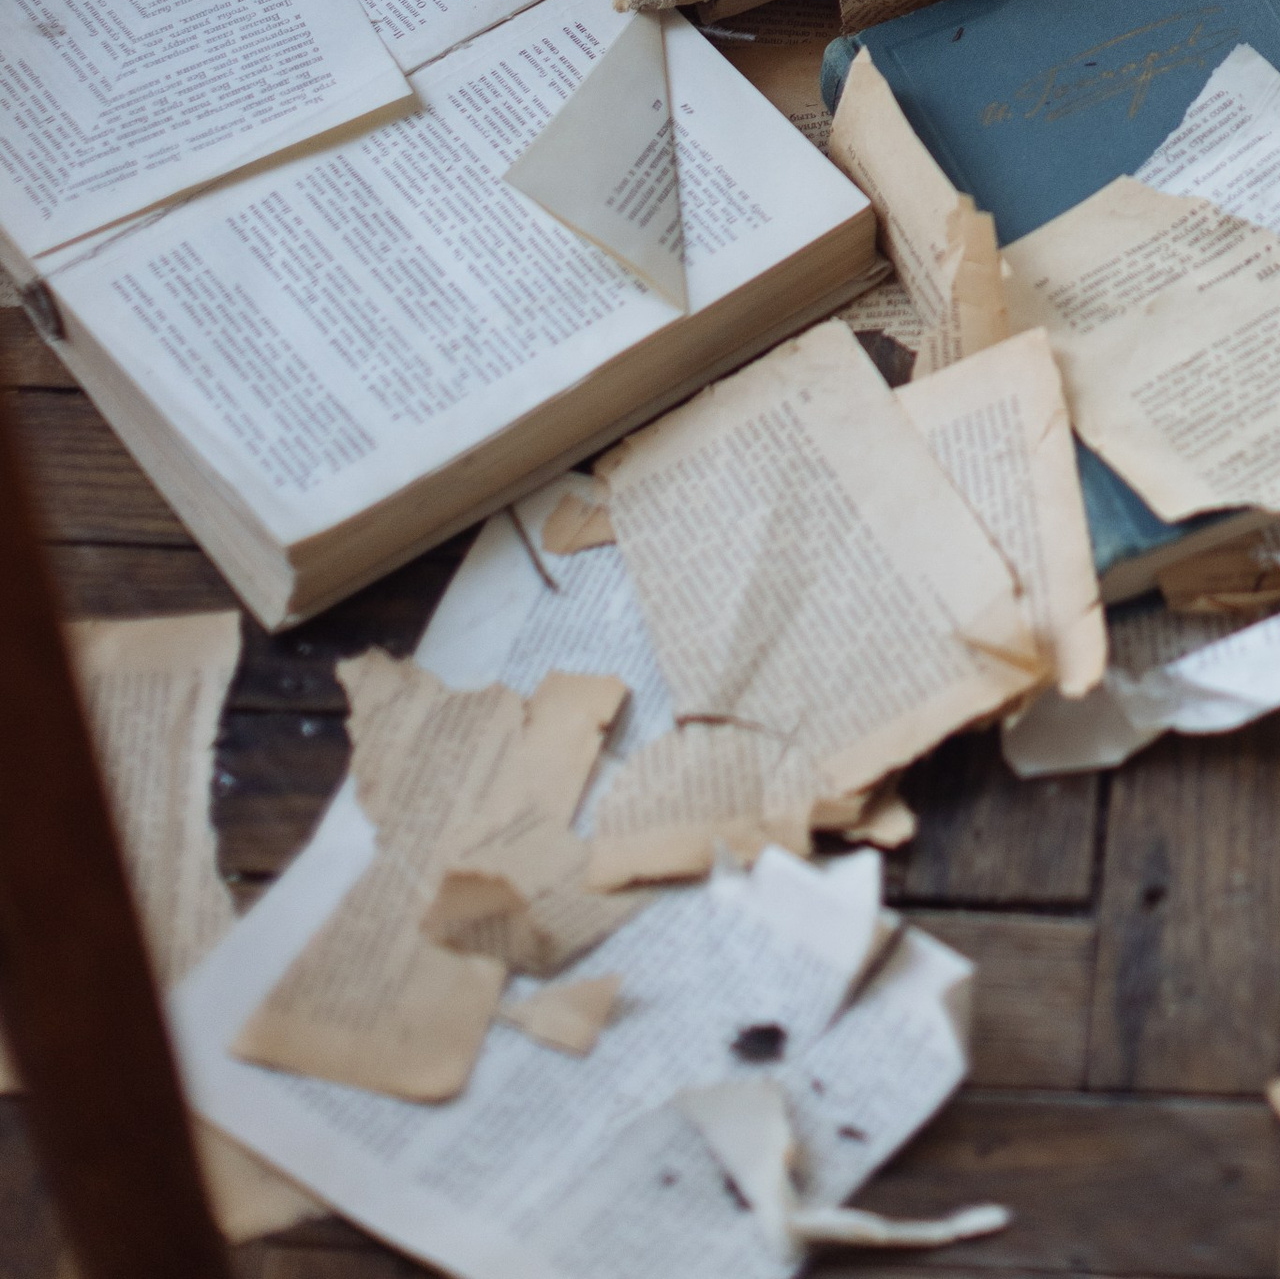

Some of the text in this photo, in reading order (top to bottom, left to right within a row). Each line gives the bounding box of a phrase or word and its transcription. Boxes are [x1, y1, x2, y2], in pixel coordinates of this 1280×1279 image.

[202, 11, 257, 35] сбивались
[161, 33, 198, 52] вокруг
[241, 29, 311, 60] болезненный
